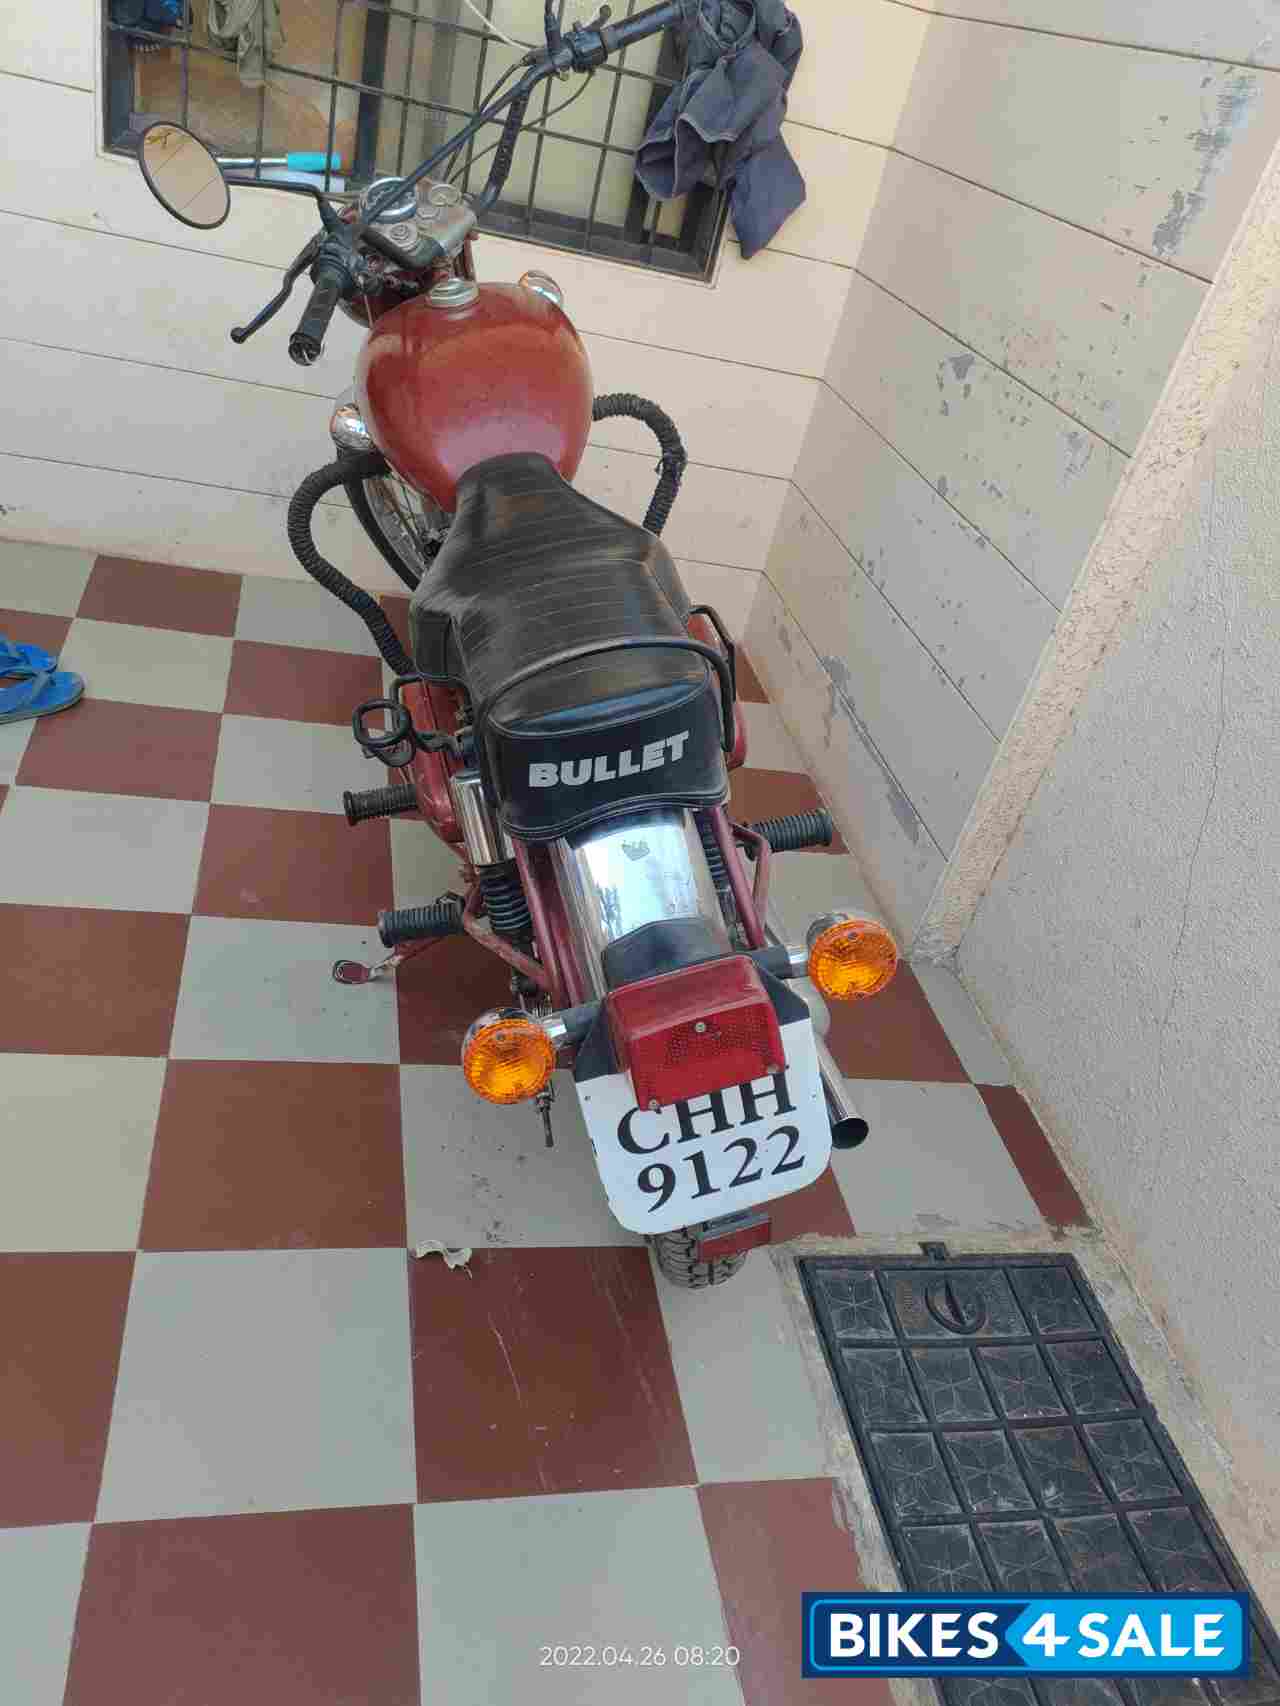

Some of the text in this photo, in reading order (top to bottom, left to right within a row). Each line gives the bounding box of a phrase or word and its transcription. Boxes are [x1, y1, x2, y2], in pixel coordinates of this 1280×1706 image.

[528, 730, 690, 788] BULLET
[616, 1072, 798, 1155] CHH
[637, 1125, 806, 1214] 9122
